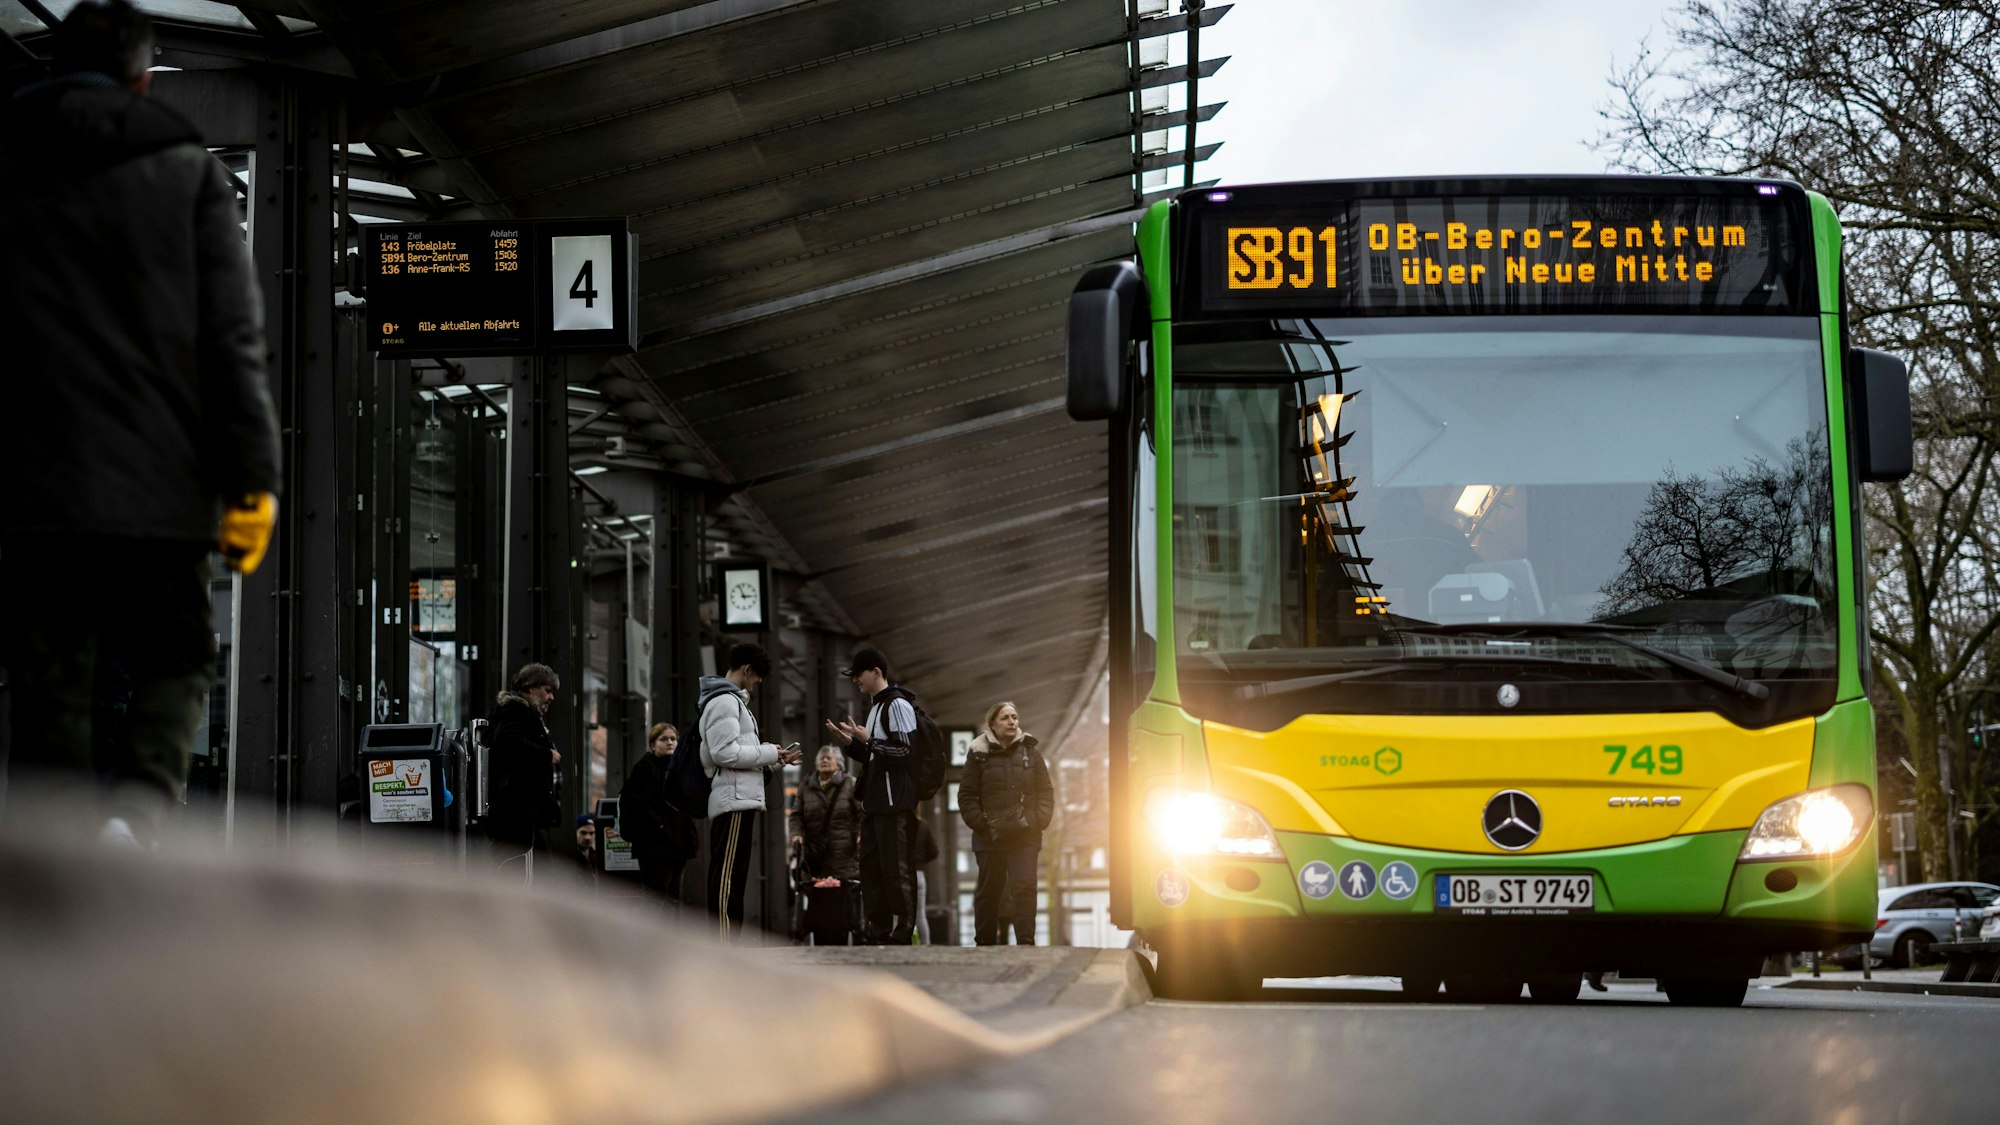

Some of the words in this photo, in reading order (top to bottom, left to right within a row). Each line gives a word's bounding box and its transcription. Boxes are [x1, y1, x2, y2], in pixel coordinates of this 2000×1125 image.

[380, 233, 399, 241] Linie
[407, 232, 422, 240] Ziel
[490, 230, 519, 238] Abfahrt
[381, 242, 400, 252] 143
[407, 241, 457, 252] Fröbelplatz
[494, 239, 517, 248] 14:59
[381, 253, 406, 263] SB91
[407, 252, 469, 262] Bero-Zentrum
[494, 250, 517, 260] 15:06
[1228, 226, 1337, 289] SB91
[1368, 220, 1746, 251] OB-Bero-Zentrum
[381, 265, 400, 275] 136
[407, 262, 471, 274] Anne-Frank-RS
[494, 261, 518, 271] 15:20
[1402, 257, 1486, 285] über
[1506, 256, 1595, 284] Neue
[1616, 255, 1713, 282] Mitte
[569, 259, 598, 308] 4
[418, 321, 437, 332] Alle
[439, 320, 480, 331] aktuellen
[959, 740, 967, 756] 3
[373, 761, 391, 770] MACH
[1320, 755, 1371, 766] STOAG
[1602, 745, 1683, 776] 749
[374, 782, 404, 790] RESPEKT.
[1607, 796, 1683, 808] CITARO
[1453, 879, 1480, 903] OB
[1499, 879, 1527, 903] ST
[1534, 879, 1590, 903] 9749
